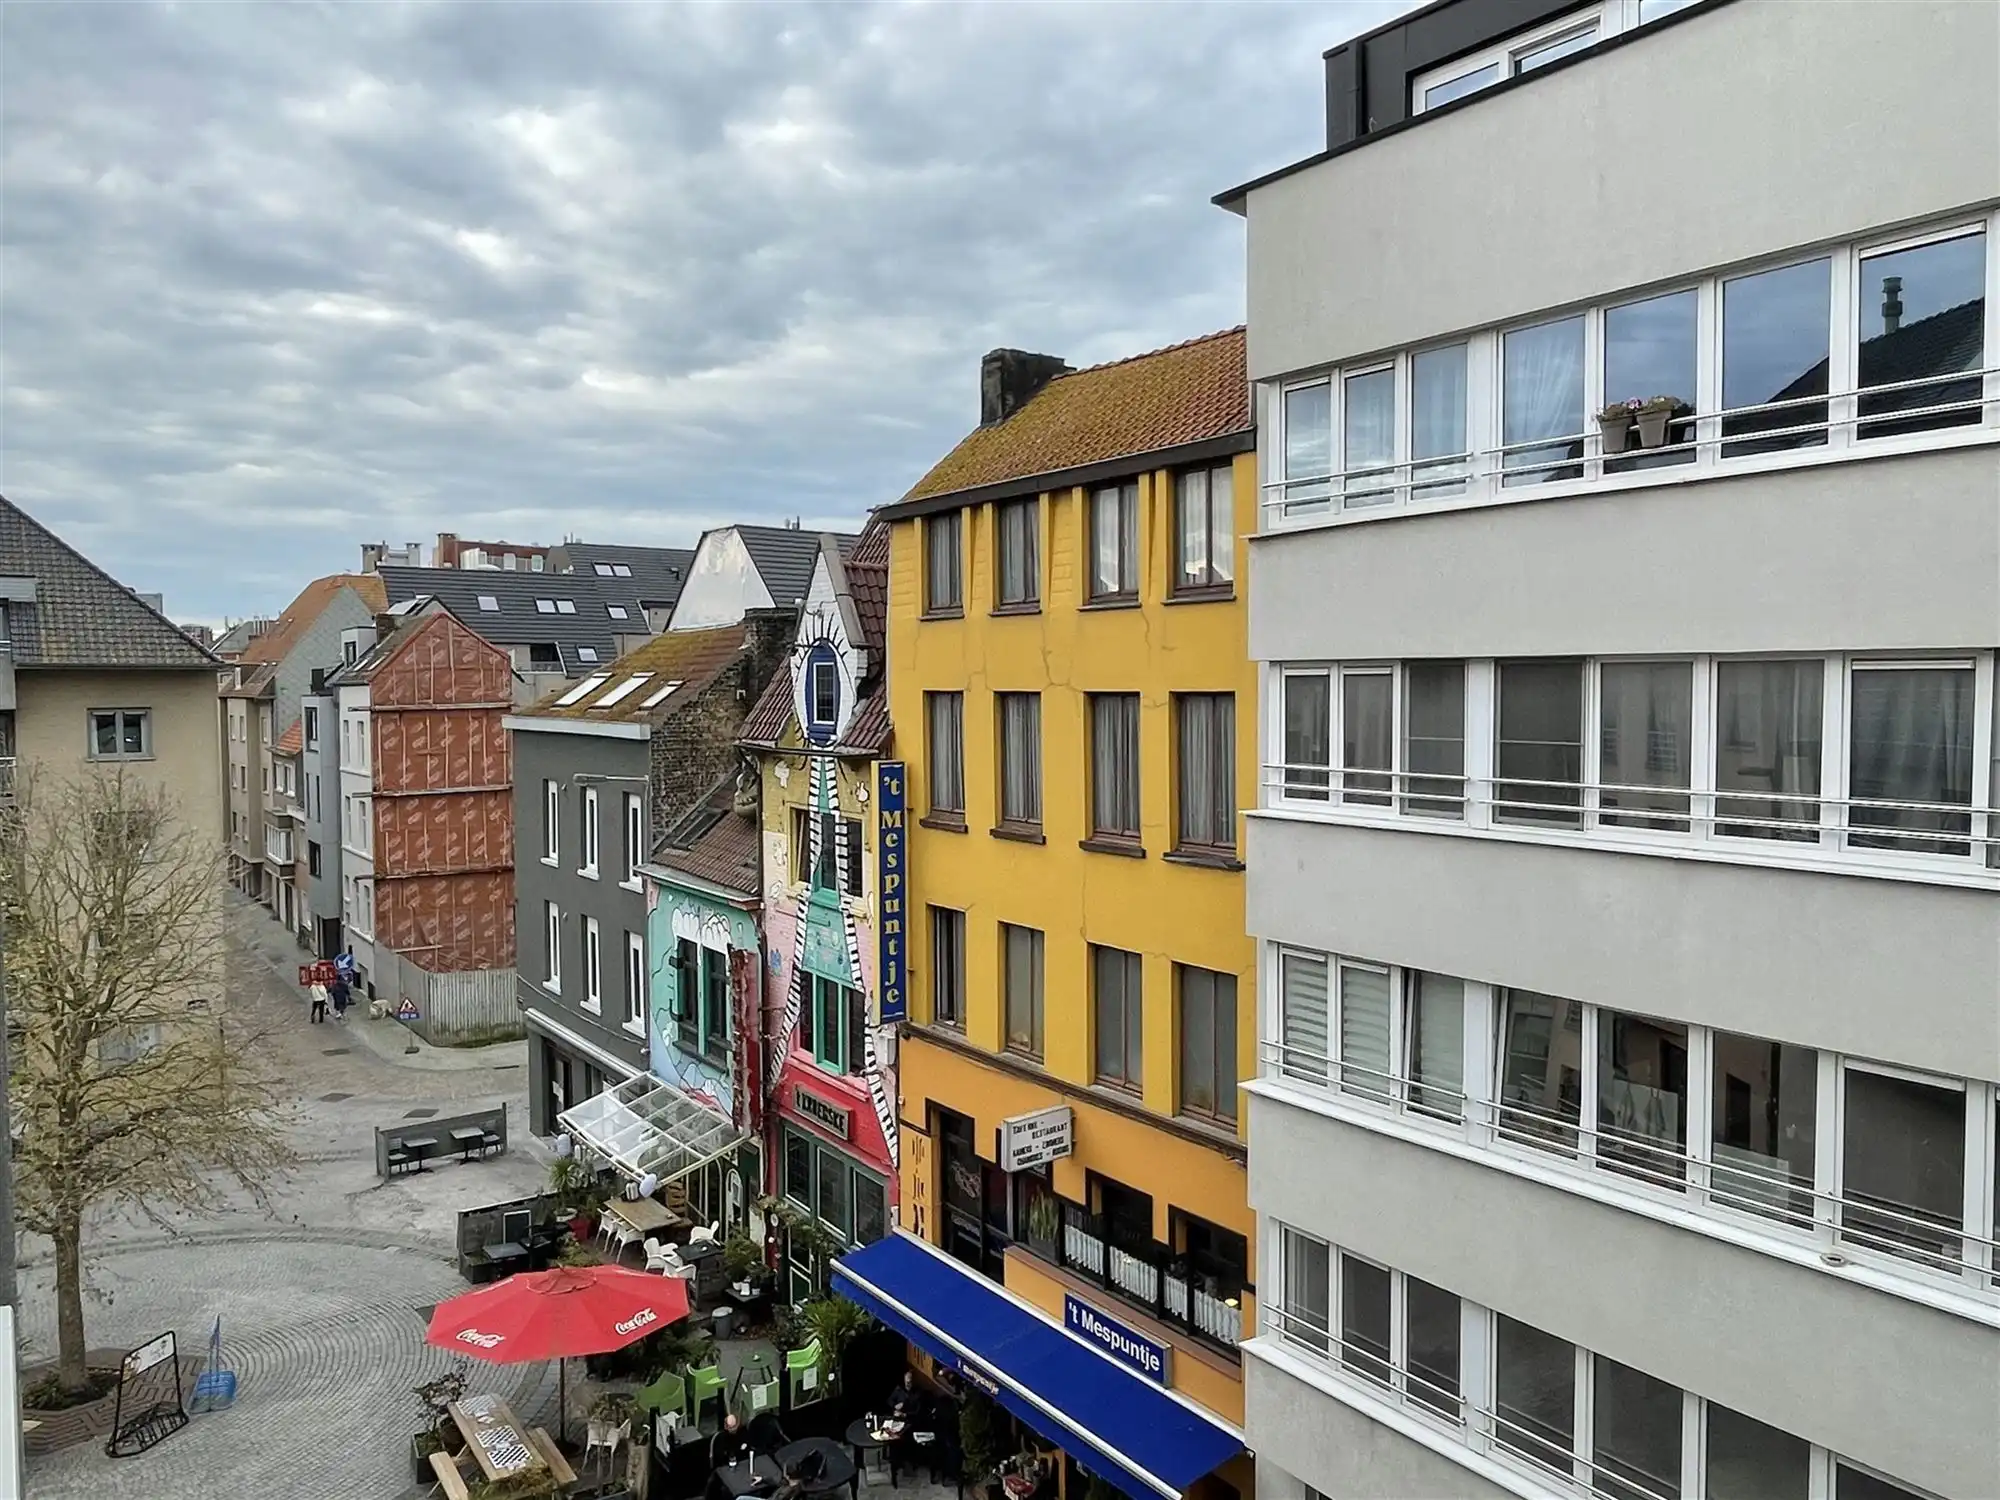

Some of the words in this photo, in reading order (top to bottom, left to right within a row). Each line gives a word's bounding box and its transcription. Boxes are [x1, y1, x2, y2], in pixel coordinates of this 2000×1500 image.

[884, 776, 901, 796] 't
[1068, 1302, 1079, 1324] 't
[1081, 1309, 1160, 1372] Mespuntje
